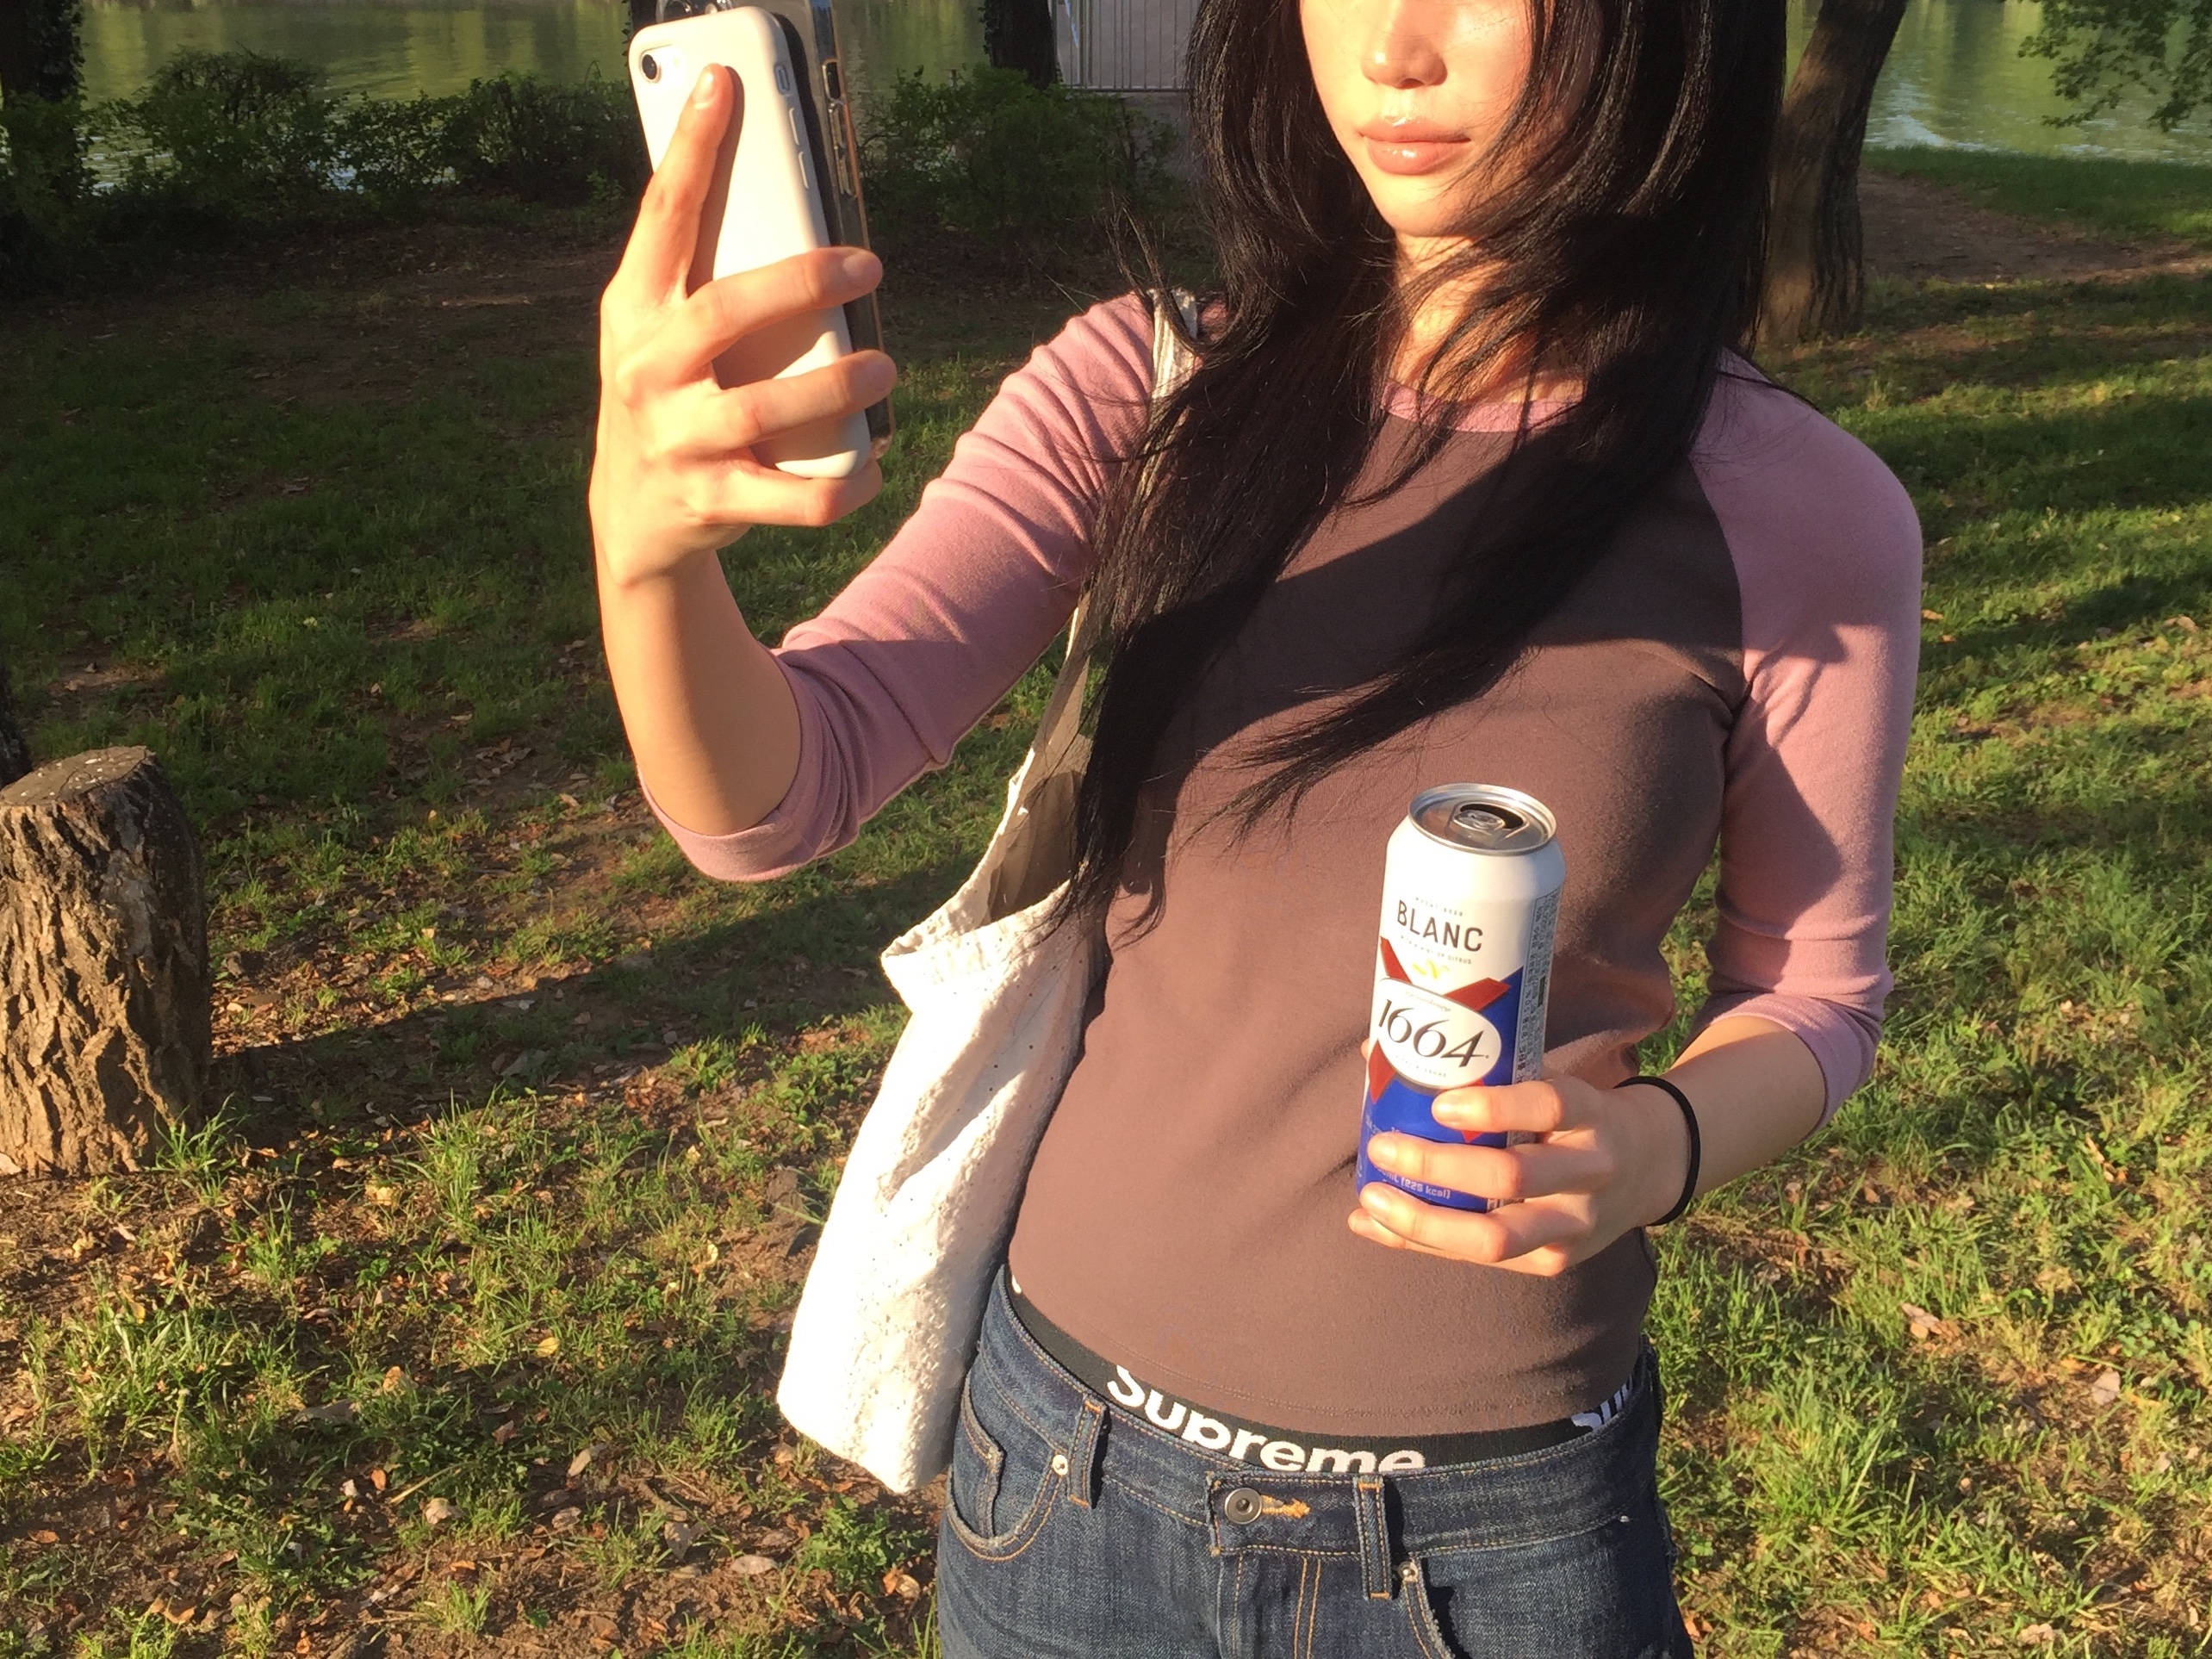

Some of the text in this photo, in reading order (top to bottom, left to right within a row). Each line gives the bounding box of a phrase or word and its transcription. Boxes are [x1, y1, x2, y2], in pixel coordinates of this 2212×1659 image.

[1396, 899, 1483, 952] BLANC
[1378, 998, 1485, 1068] 1664
[1107, 1364, 1426, 1473] Supreme
